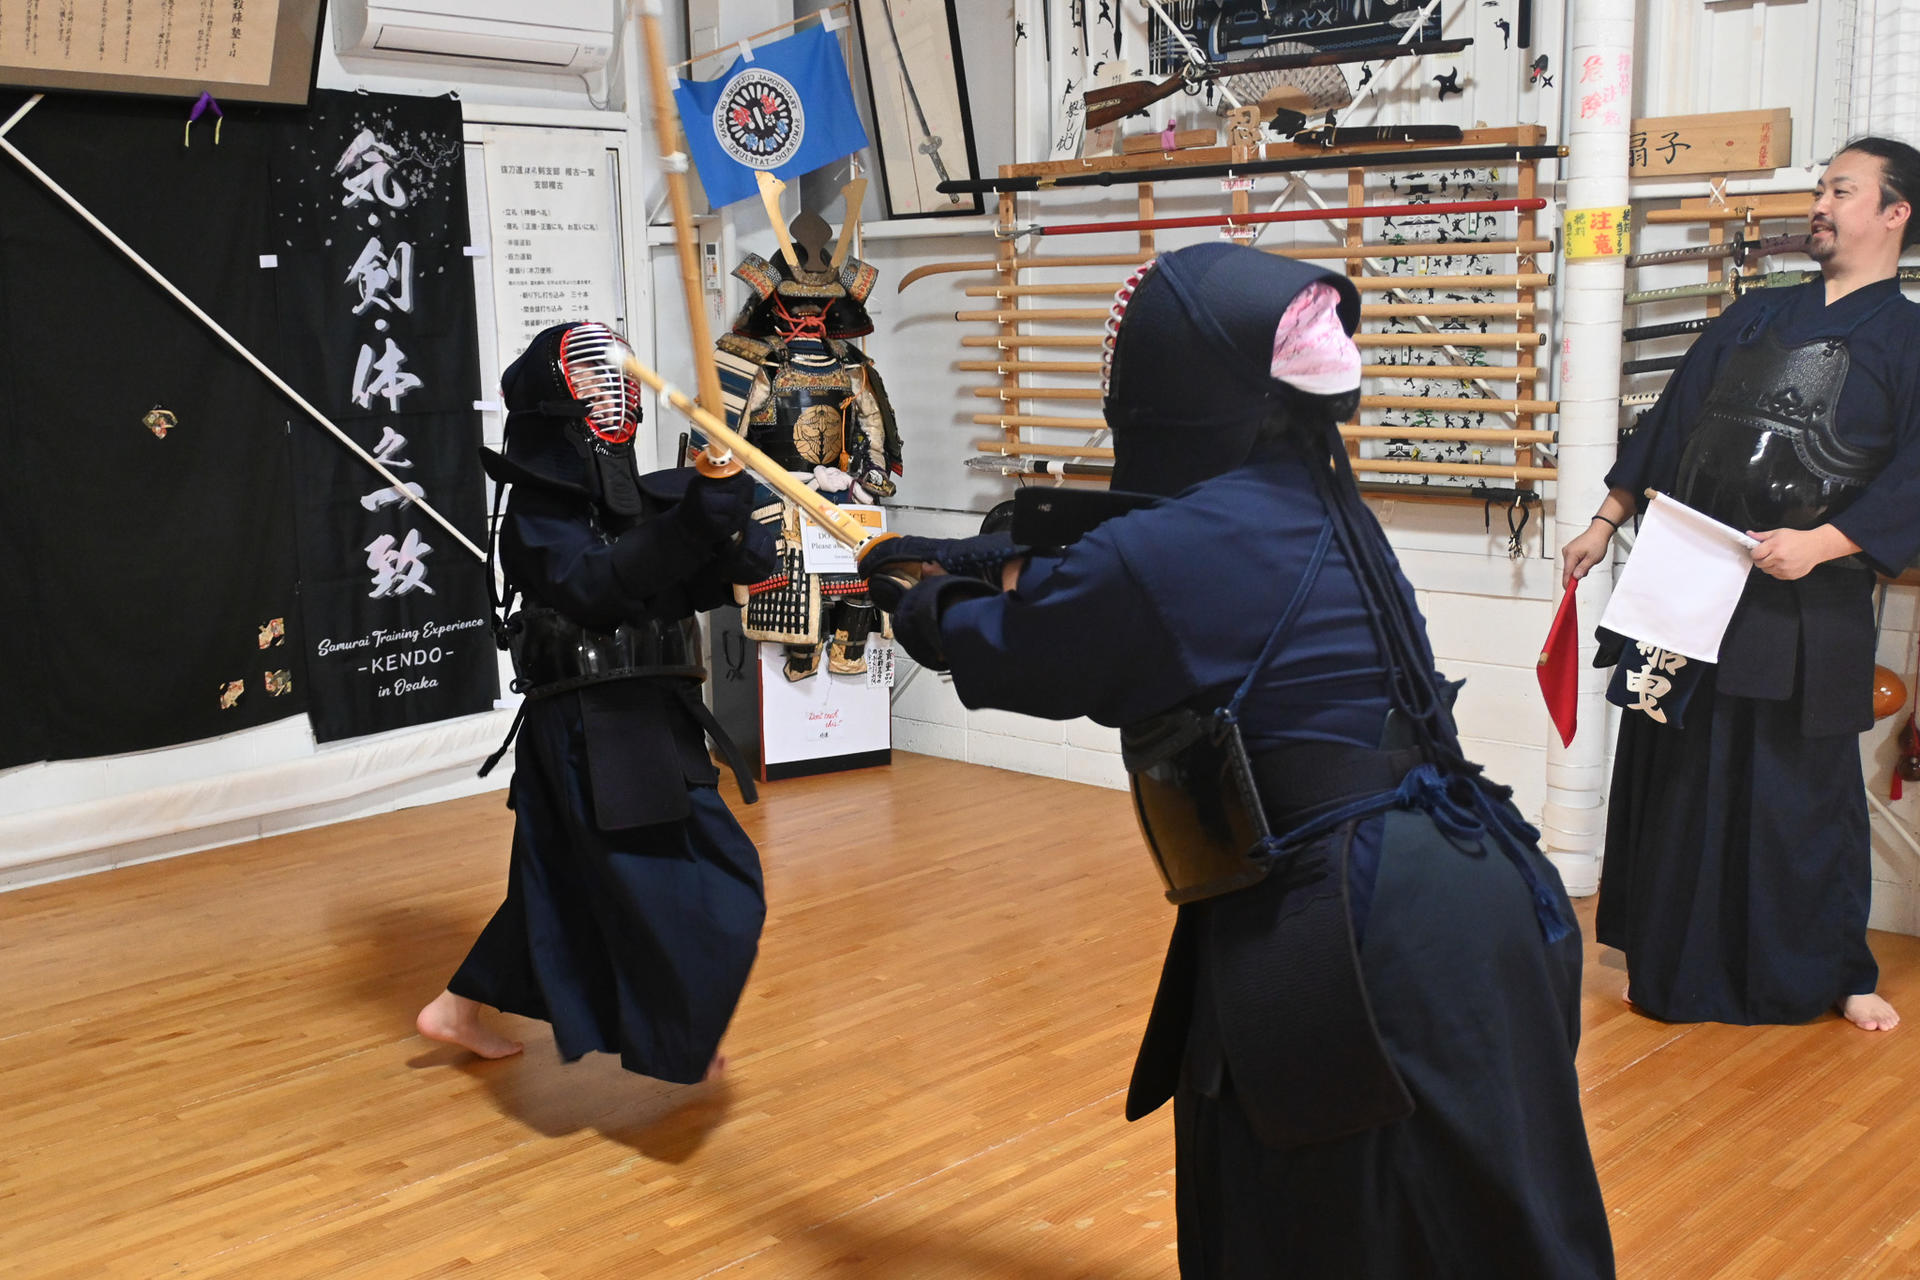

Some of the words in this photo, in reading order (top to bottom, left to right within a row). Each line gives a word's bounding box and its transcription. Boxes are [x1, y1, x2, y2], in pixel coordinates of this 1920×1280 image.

[1629, 132, 1691, 167] 扇子
[1590, 211, 1613, 254] 注意
[318, 635, 371, 656] Samurai
[372, 627, 419, 648] Training
[423, 618, 485, 638] Experience
[378, 686, 391, 697] in
[394, 676, 439, 696] Osaka
